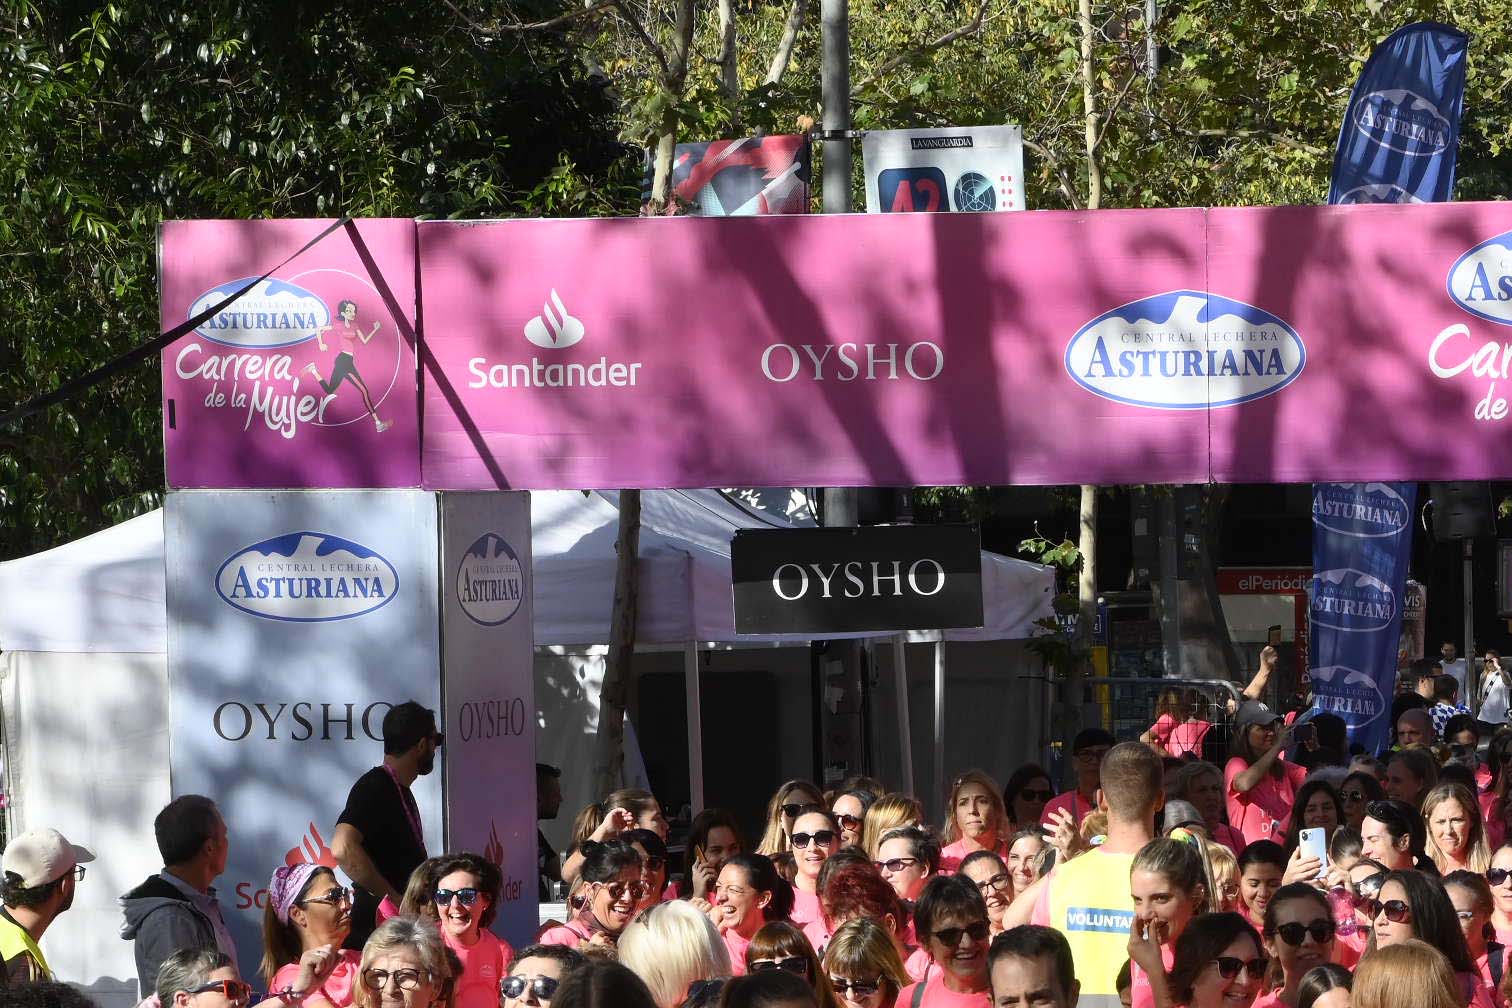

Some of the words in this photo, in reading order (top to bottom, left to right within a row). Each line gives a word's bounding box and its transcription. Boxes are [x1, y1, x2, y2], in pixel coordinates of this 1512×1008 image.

[1360, 103, 1445, 146] ASTURIANA
[202, 303, 318, 330] ASTURIANA
[1121, 332, 1198, 344] CENTRAL
[1205, 330, 1279, 342] LECHERA
[175, 343, 293, 381] Carrera
[468, 357, 641, 388] Santander
[760, 341, 944, 383] OYSHO
[1084, 335, 1286, 379] ASTURIANA
[204, 382, 226, 408] de
[231, 382, 247, 408] la
[244, 372, 337, 439] Mujer
[1474, 382, 1509, 420] de
[1313, 491, 1401, 526] ASTURIANA
[230, 565, 386, 599] ASTURIANA
[257, 563, 318, 573] CENTRAL
[321, 563, 379, 573] LECHERA
[462, 567, 520, 602] ASTURIANA
[772, 559, 946, 600] OYSHO
[459, 698, 525, 742] OYSHO
